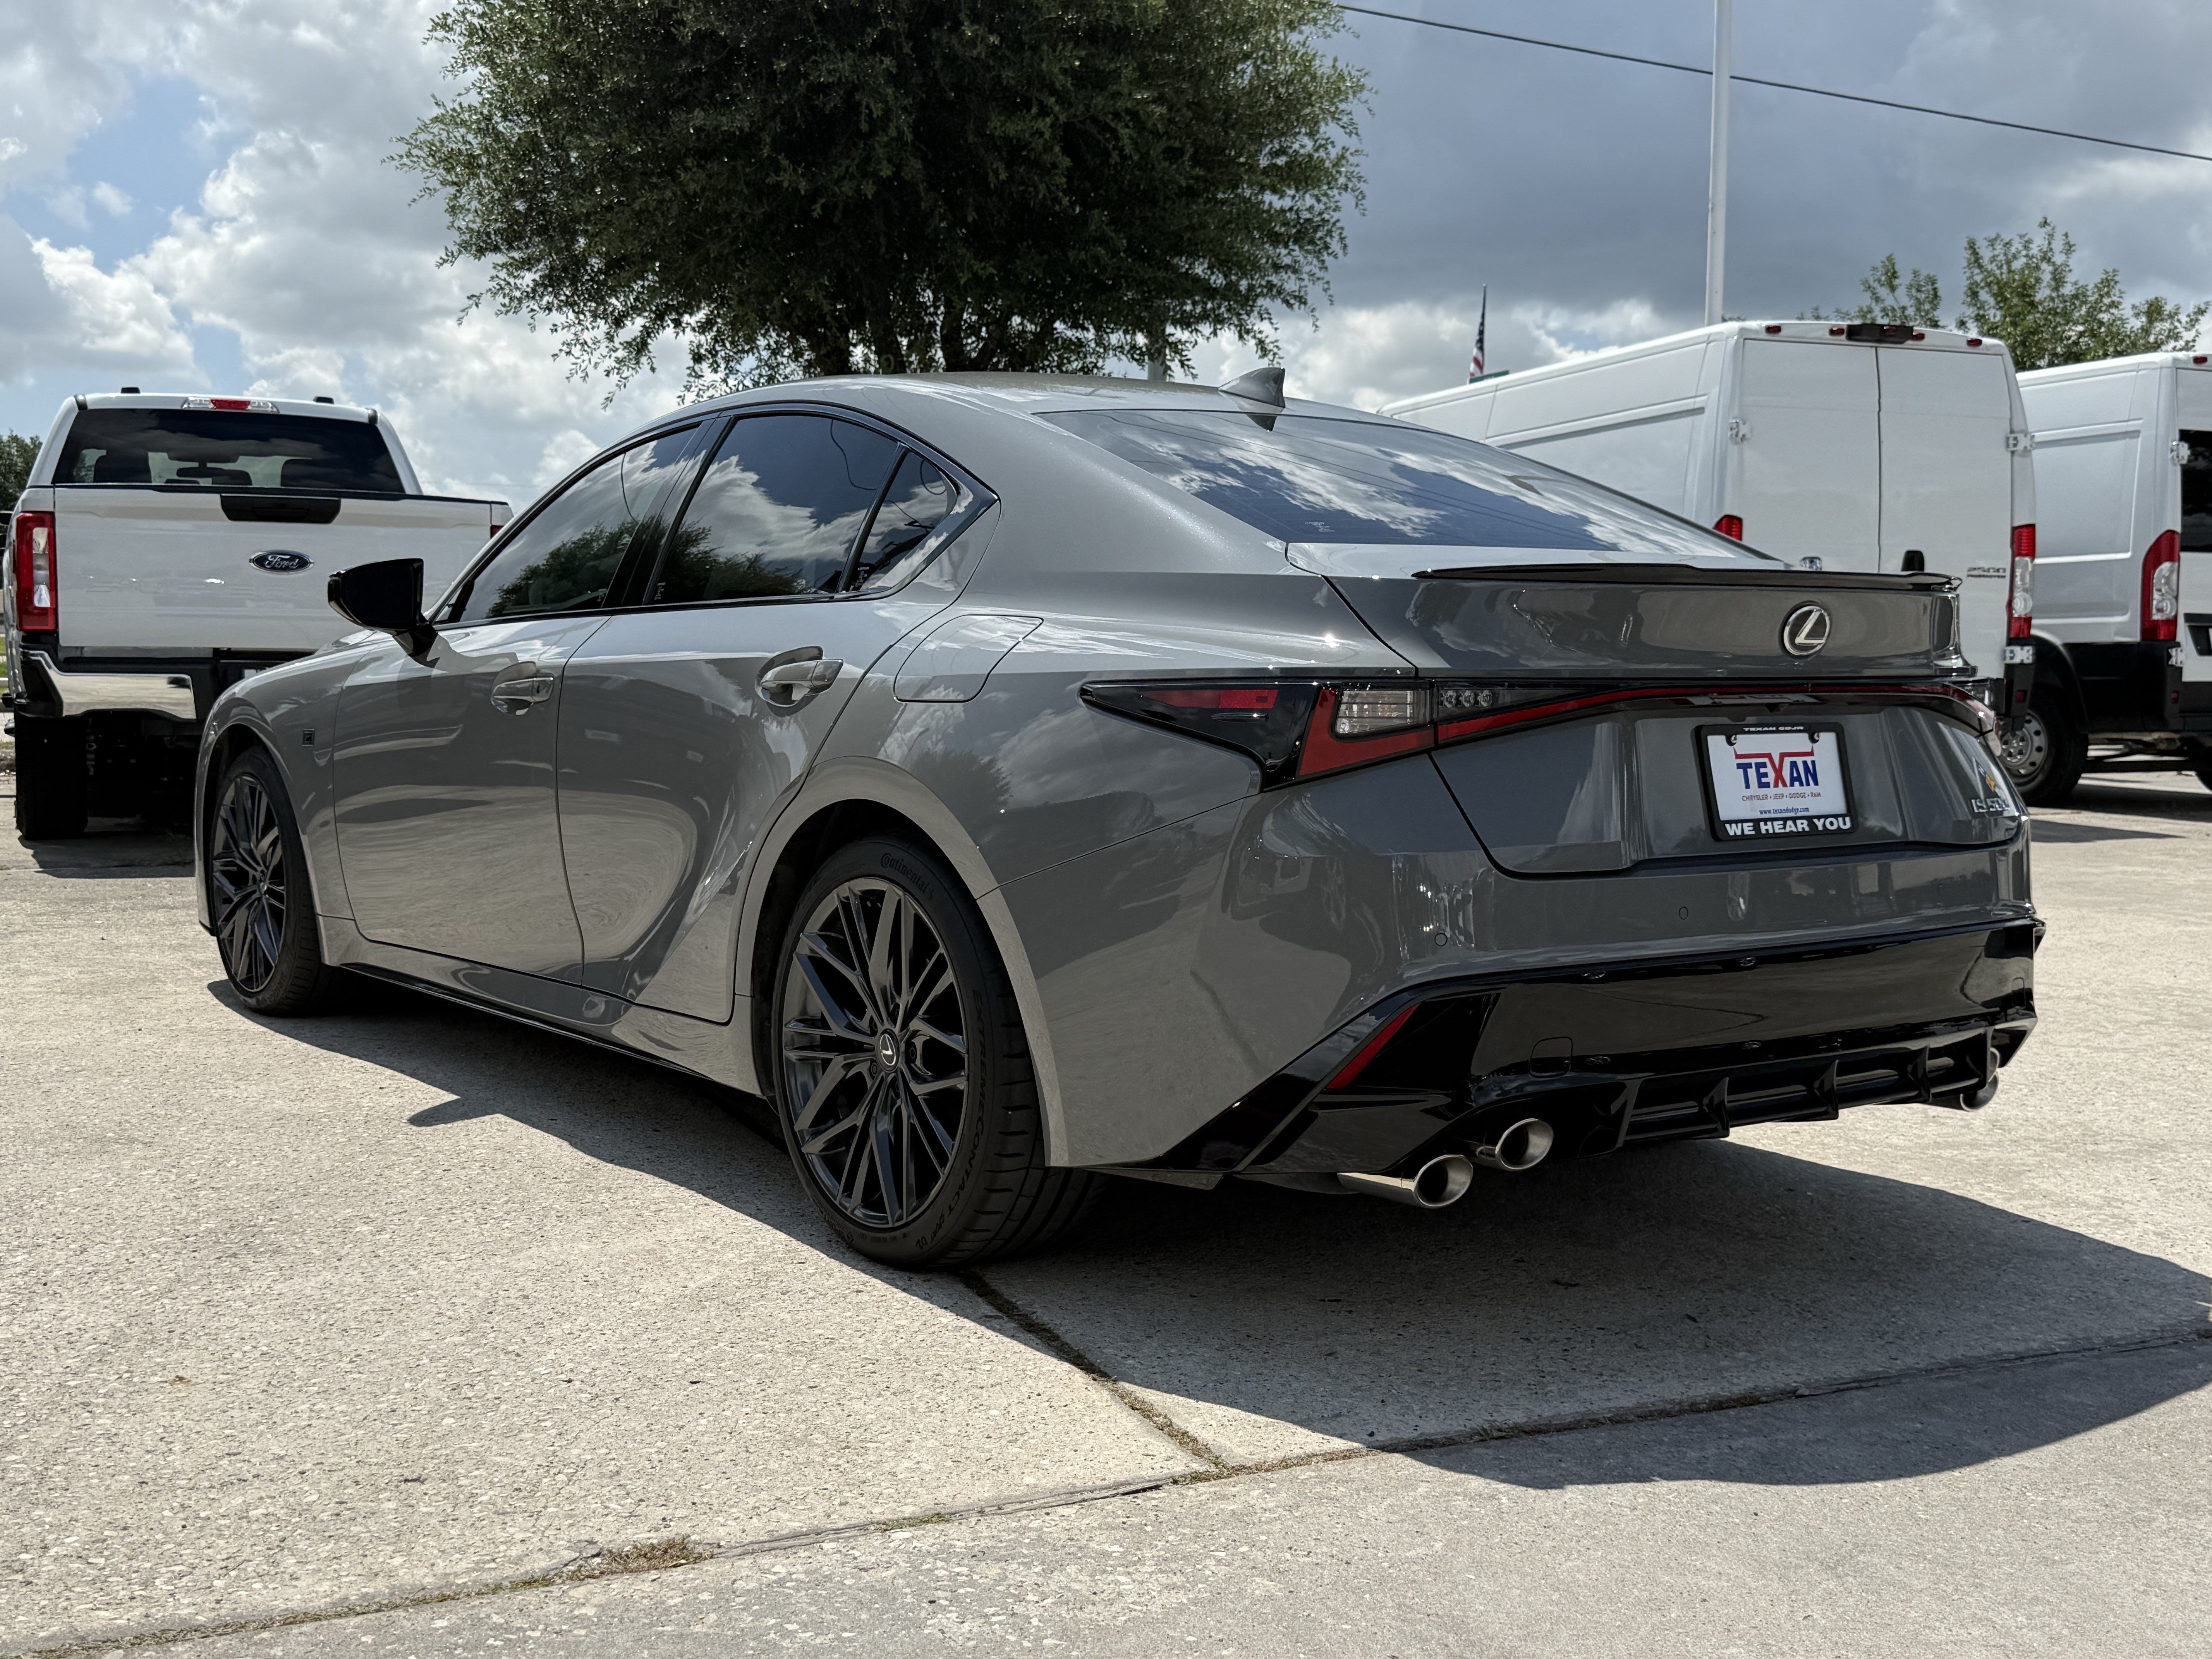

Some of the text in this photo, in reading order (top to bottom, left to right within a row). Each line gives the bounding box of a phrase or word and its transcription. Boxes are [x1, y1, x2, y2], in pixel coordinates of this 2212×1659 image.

[265, 555, 299, 568] Ford
[1736, 752, 1819, 789] TEXAN
[1725, 817, 1851, 836] WE HEAR YOU
[880, 853, 929, 894] Continental
